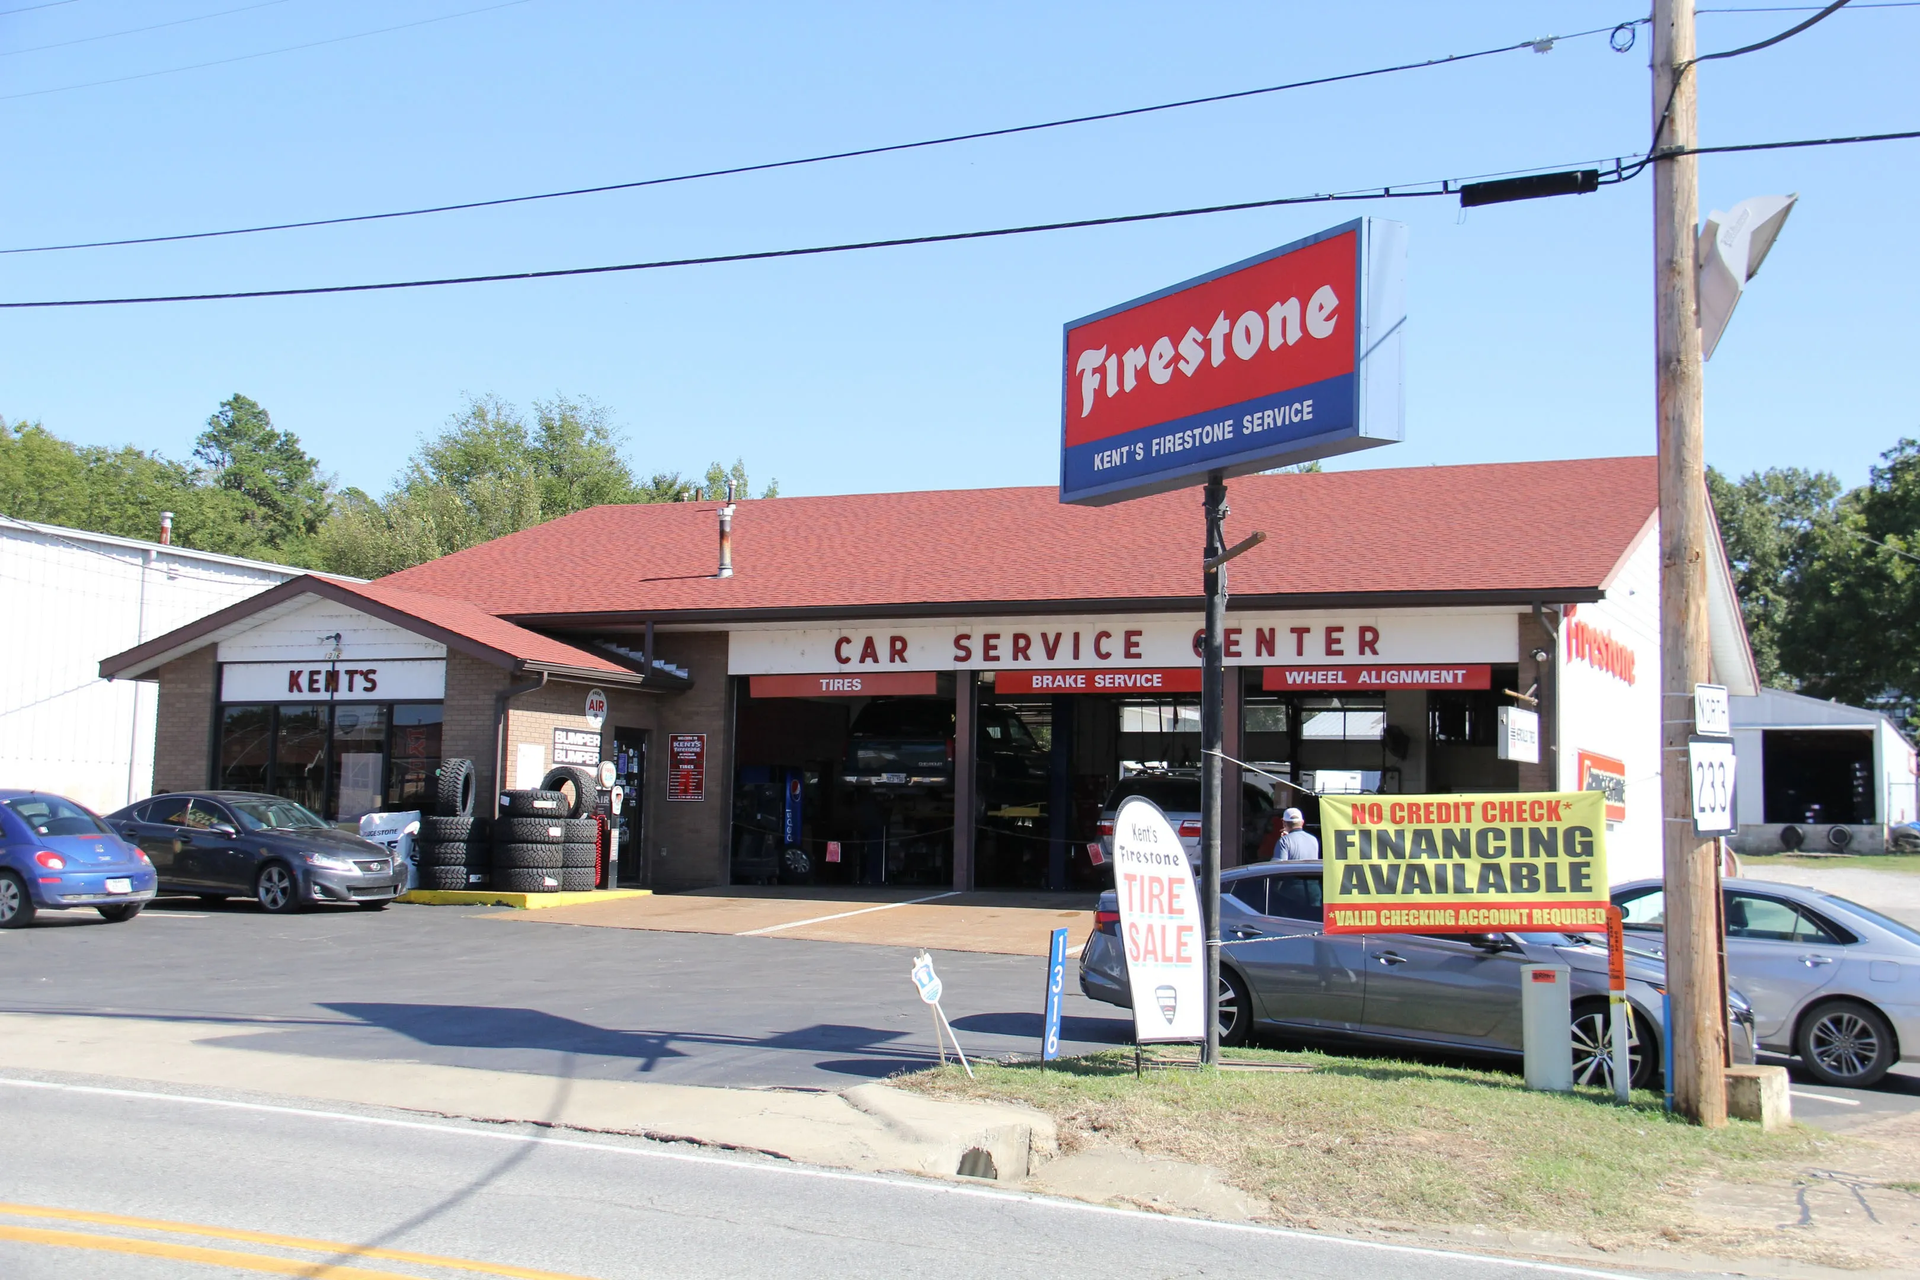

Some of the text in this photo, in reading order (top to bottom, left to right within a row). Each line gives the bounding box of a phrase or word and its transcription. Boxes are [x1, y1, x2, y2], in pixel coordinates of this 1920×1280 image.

[1076, 284, 1339, 418] Firestone
[1094, 399, 1313, 471] KENT'S FIRESTONE SERVICE
[834, 625, 1380, 665] CAR SERVICE CENTER
[1566, 604, 1636, 687] Firestone
[288, 669, 377, 693] KENT'S
[820, 678, 862, 691] TIRES
[1032, 674, 1162, 688] BRAKE SERVICE
[1285, 670, 1466, 684] WHEEL ALIGNMENT
[588, 699, 604, 712] AIR
[1698, 693, 1727, 724] NORTH
[555, 730, 601, 747] BUMPER
[554, 750, 600, 765] BUMPER
[1696, 761, 1727, 813] 233
[1351, 803, 1383, 825] NO
[1390, 802, 1475, 824] CREDIT
[1131, 822, 1158, 844] Kent's
[1334, 825, 1594, 860] FINANCING
[1119, 845, 1180, 867] Firestone
[1339, 862, 1593, 895] AVAILABLE
[1123, 873, 1186, 916] TIRE
[1380, 910, 1455, 926] CHECKING
[1458, 909, 1530, 926] ACCOUNT
[1533, 908, 1606, 926] REQUIRED
[1128, 921, 1194, 964] SALE
[1047, 935, 1064, 1054] 1316
